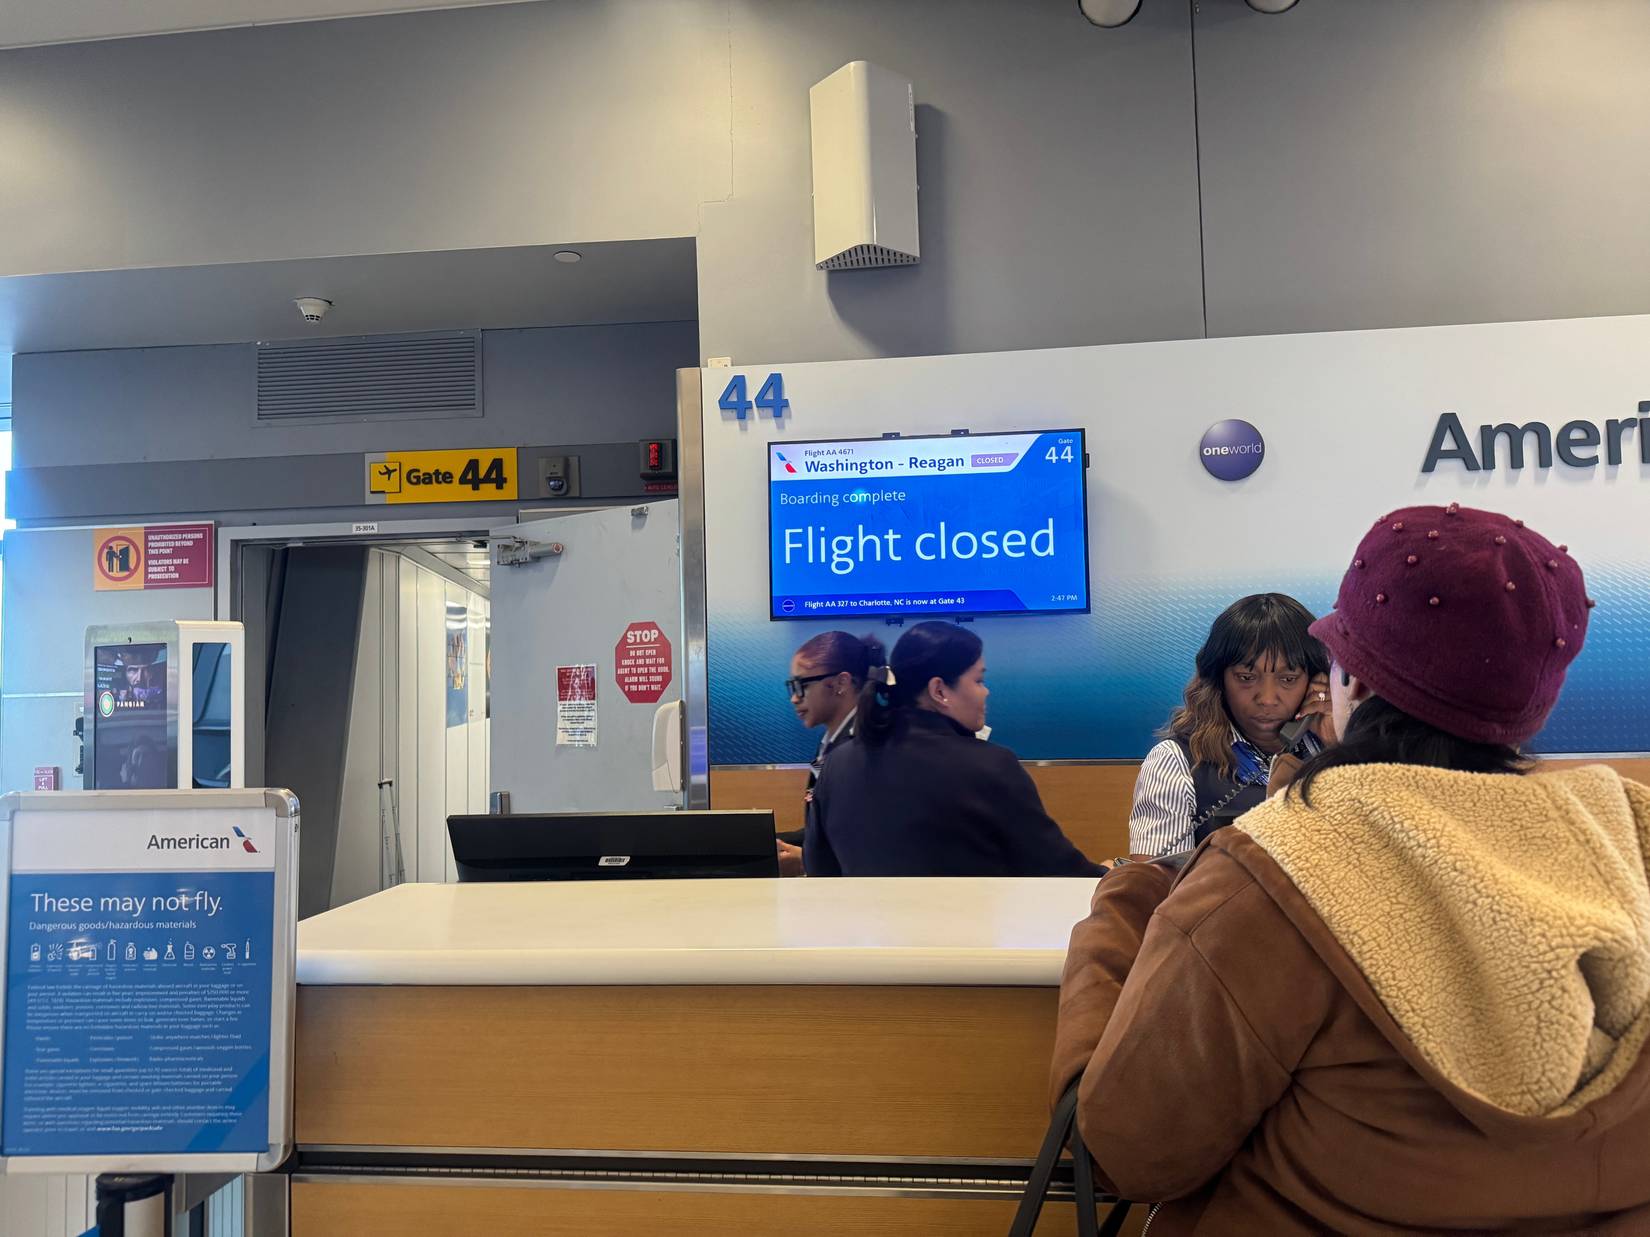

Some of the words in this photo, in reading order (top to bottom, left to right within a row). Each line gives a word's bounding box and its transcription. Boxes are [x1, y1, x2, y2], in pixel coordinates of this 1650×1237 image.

[718, 372, 789, 420] 44
[1422, 401, 1650, 473] Ameri
[1045, 446, 1074, 464] 44
[1203, 442, 1262, 456] oneworld
[805, 459, 894, 474] Washington
[909, 456, 964, 471] Reagan
[406, 468, 454, 486] Gate
[458, 458, 507, 491] 44
[780, 492, 839, 506] Boarding
[843, 490, 906, 504] complete
[784, 524, 902, 575] Flight
[914, 518, 1055, 560] closed
[805, 601, 824, 609] Flight
[626, 629, 659, 643] STOP
[147, 834, 230, 851] American
[31, 893, 93, 912] These
[100, 896, 146, 917] may
[152, 894, 189, 912] not
[194, 890, 223, 917] fly.
[29, 922, 77, 932] Dangerous
[79, 921, 154, 931] goods/hazardous
[156, 920, 196, 929] materials
